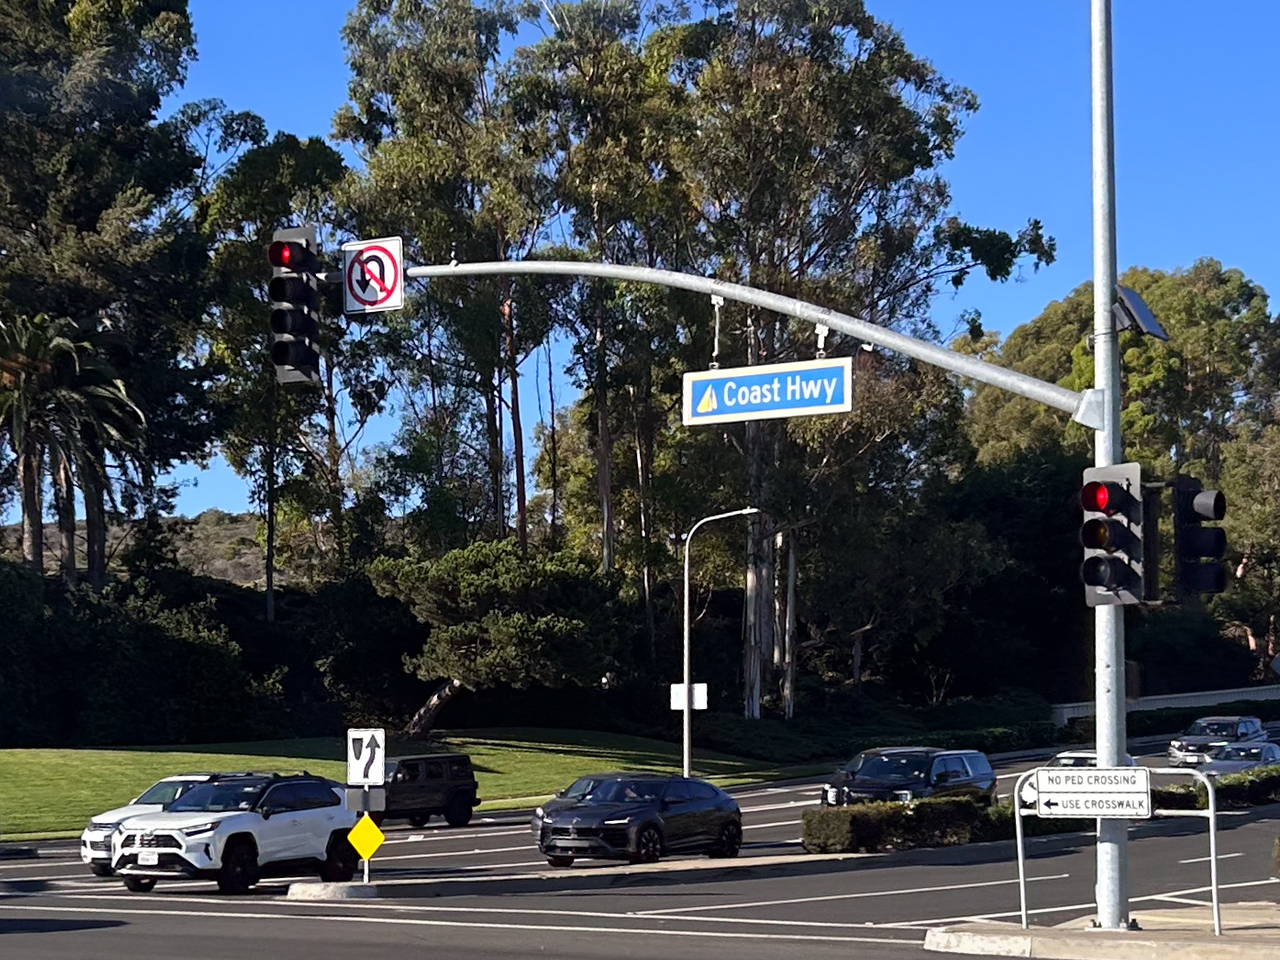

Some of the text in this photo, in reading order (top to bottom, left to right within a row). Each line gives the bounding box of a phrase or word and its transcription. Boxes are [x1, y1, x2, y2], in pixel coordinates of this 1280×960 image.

[723, 375, 837, 406] Coast Hwy
[1047, 775, 1137, 785] NO PED CROSSING
[1061, 799, 1145, 809] USE CROSSWALK
